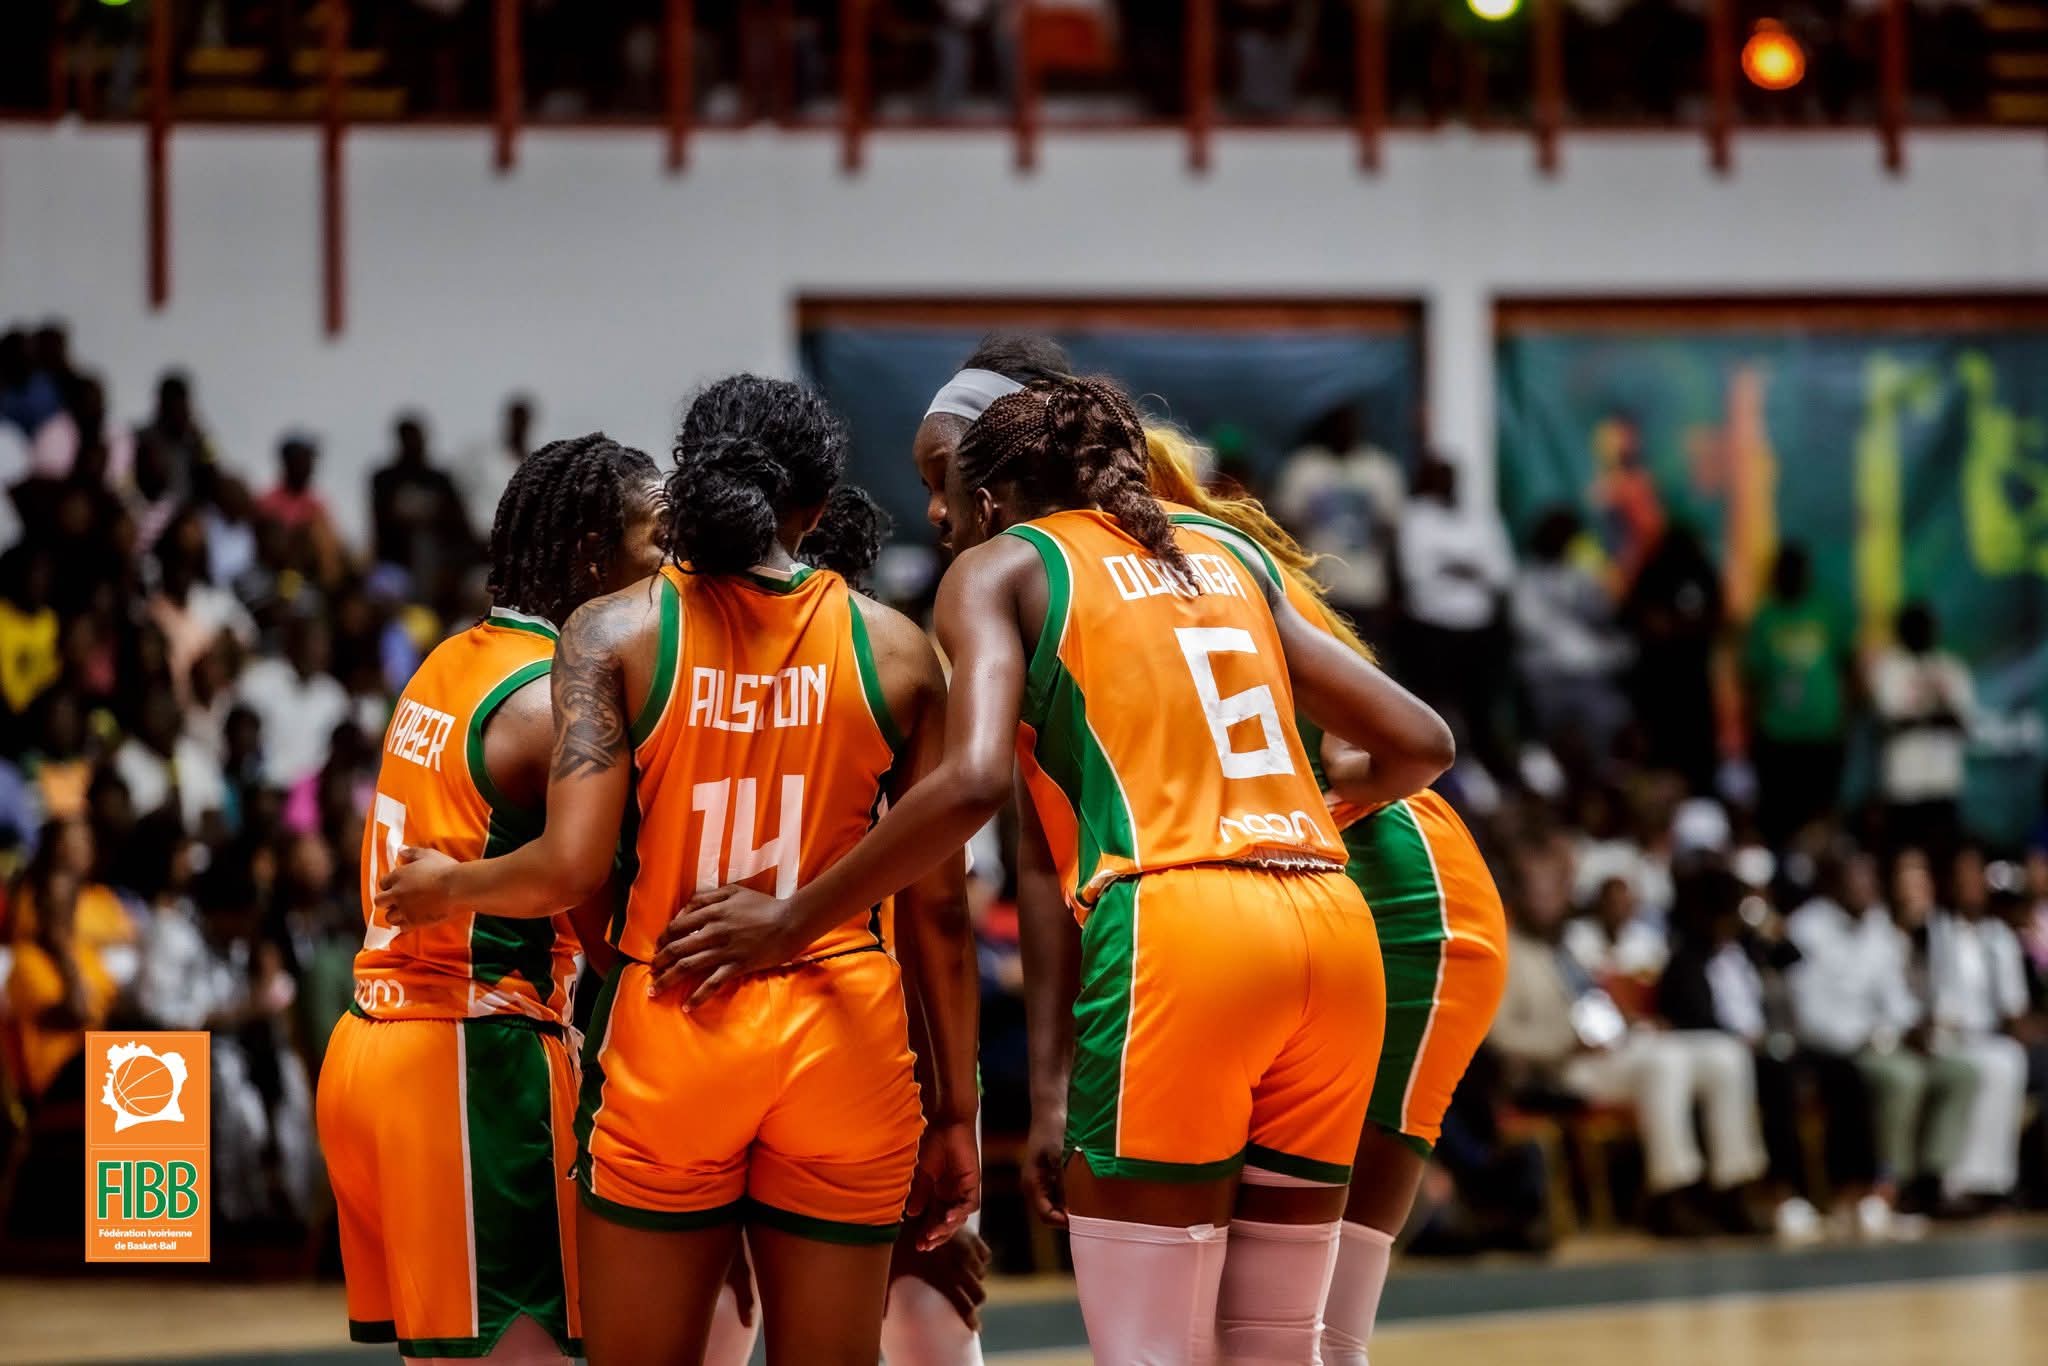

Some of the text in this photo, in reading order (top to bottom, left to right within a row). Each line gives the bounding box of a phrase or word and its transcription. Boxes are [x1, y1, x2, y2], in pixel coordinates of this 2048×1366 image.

[688, 664, 827, 733] ALSTON
[1173, 627, 1296, 779] 6
[692, 774, 805, 900] 14
